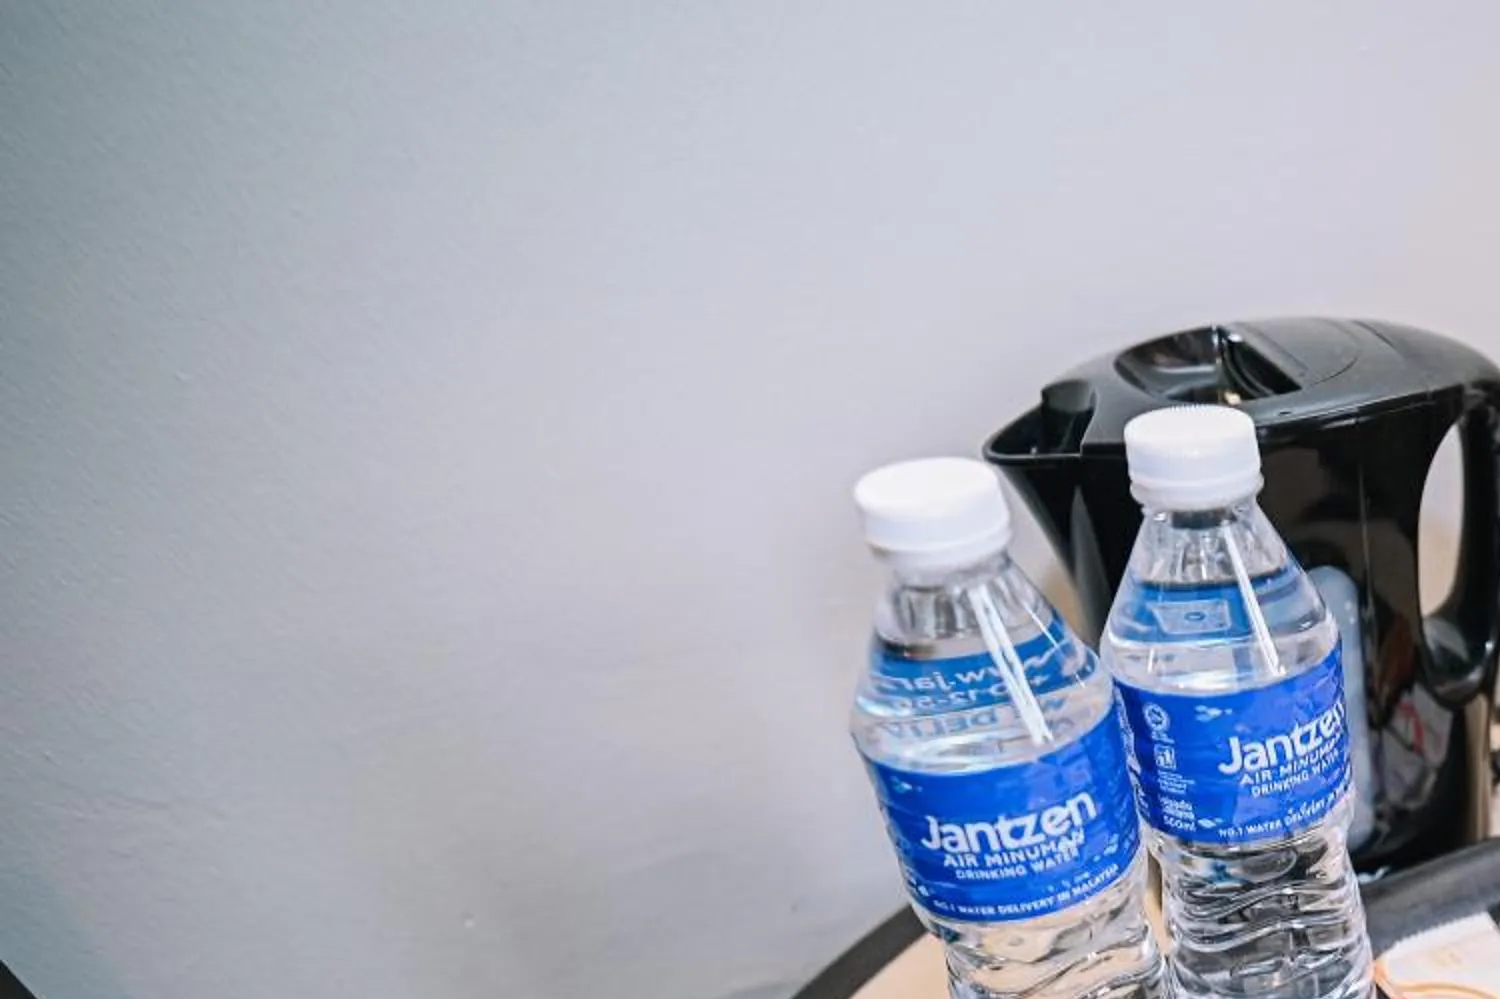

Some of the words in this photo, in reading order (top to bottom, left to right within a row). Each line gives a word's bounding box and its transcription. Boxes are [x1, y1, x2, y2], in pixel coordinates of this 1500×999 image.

[1218, 700, 1344, 774] Jantzen
[1240, 770, 1272, 785] AIR
[921, 792, 1097, 853] Jantzen
[944, 854, 978, 867] AIR
[986, 827, 1084, 867] MINUMAN
[955, 865, 1025, 880] DRINKING
[1031, 846, 1080, 872] WATER
[997, 897, 1054, 915] DELIVERY
